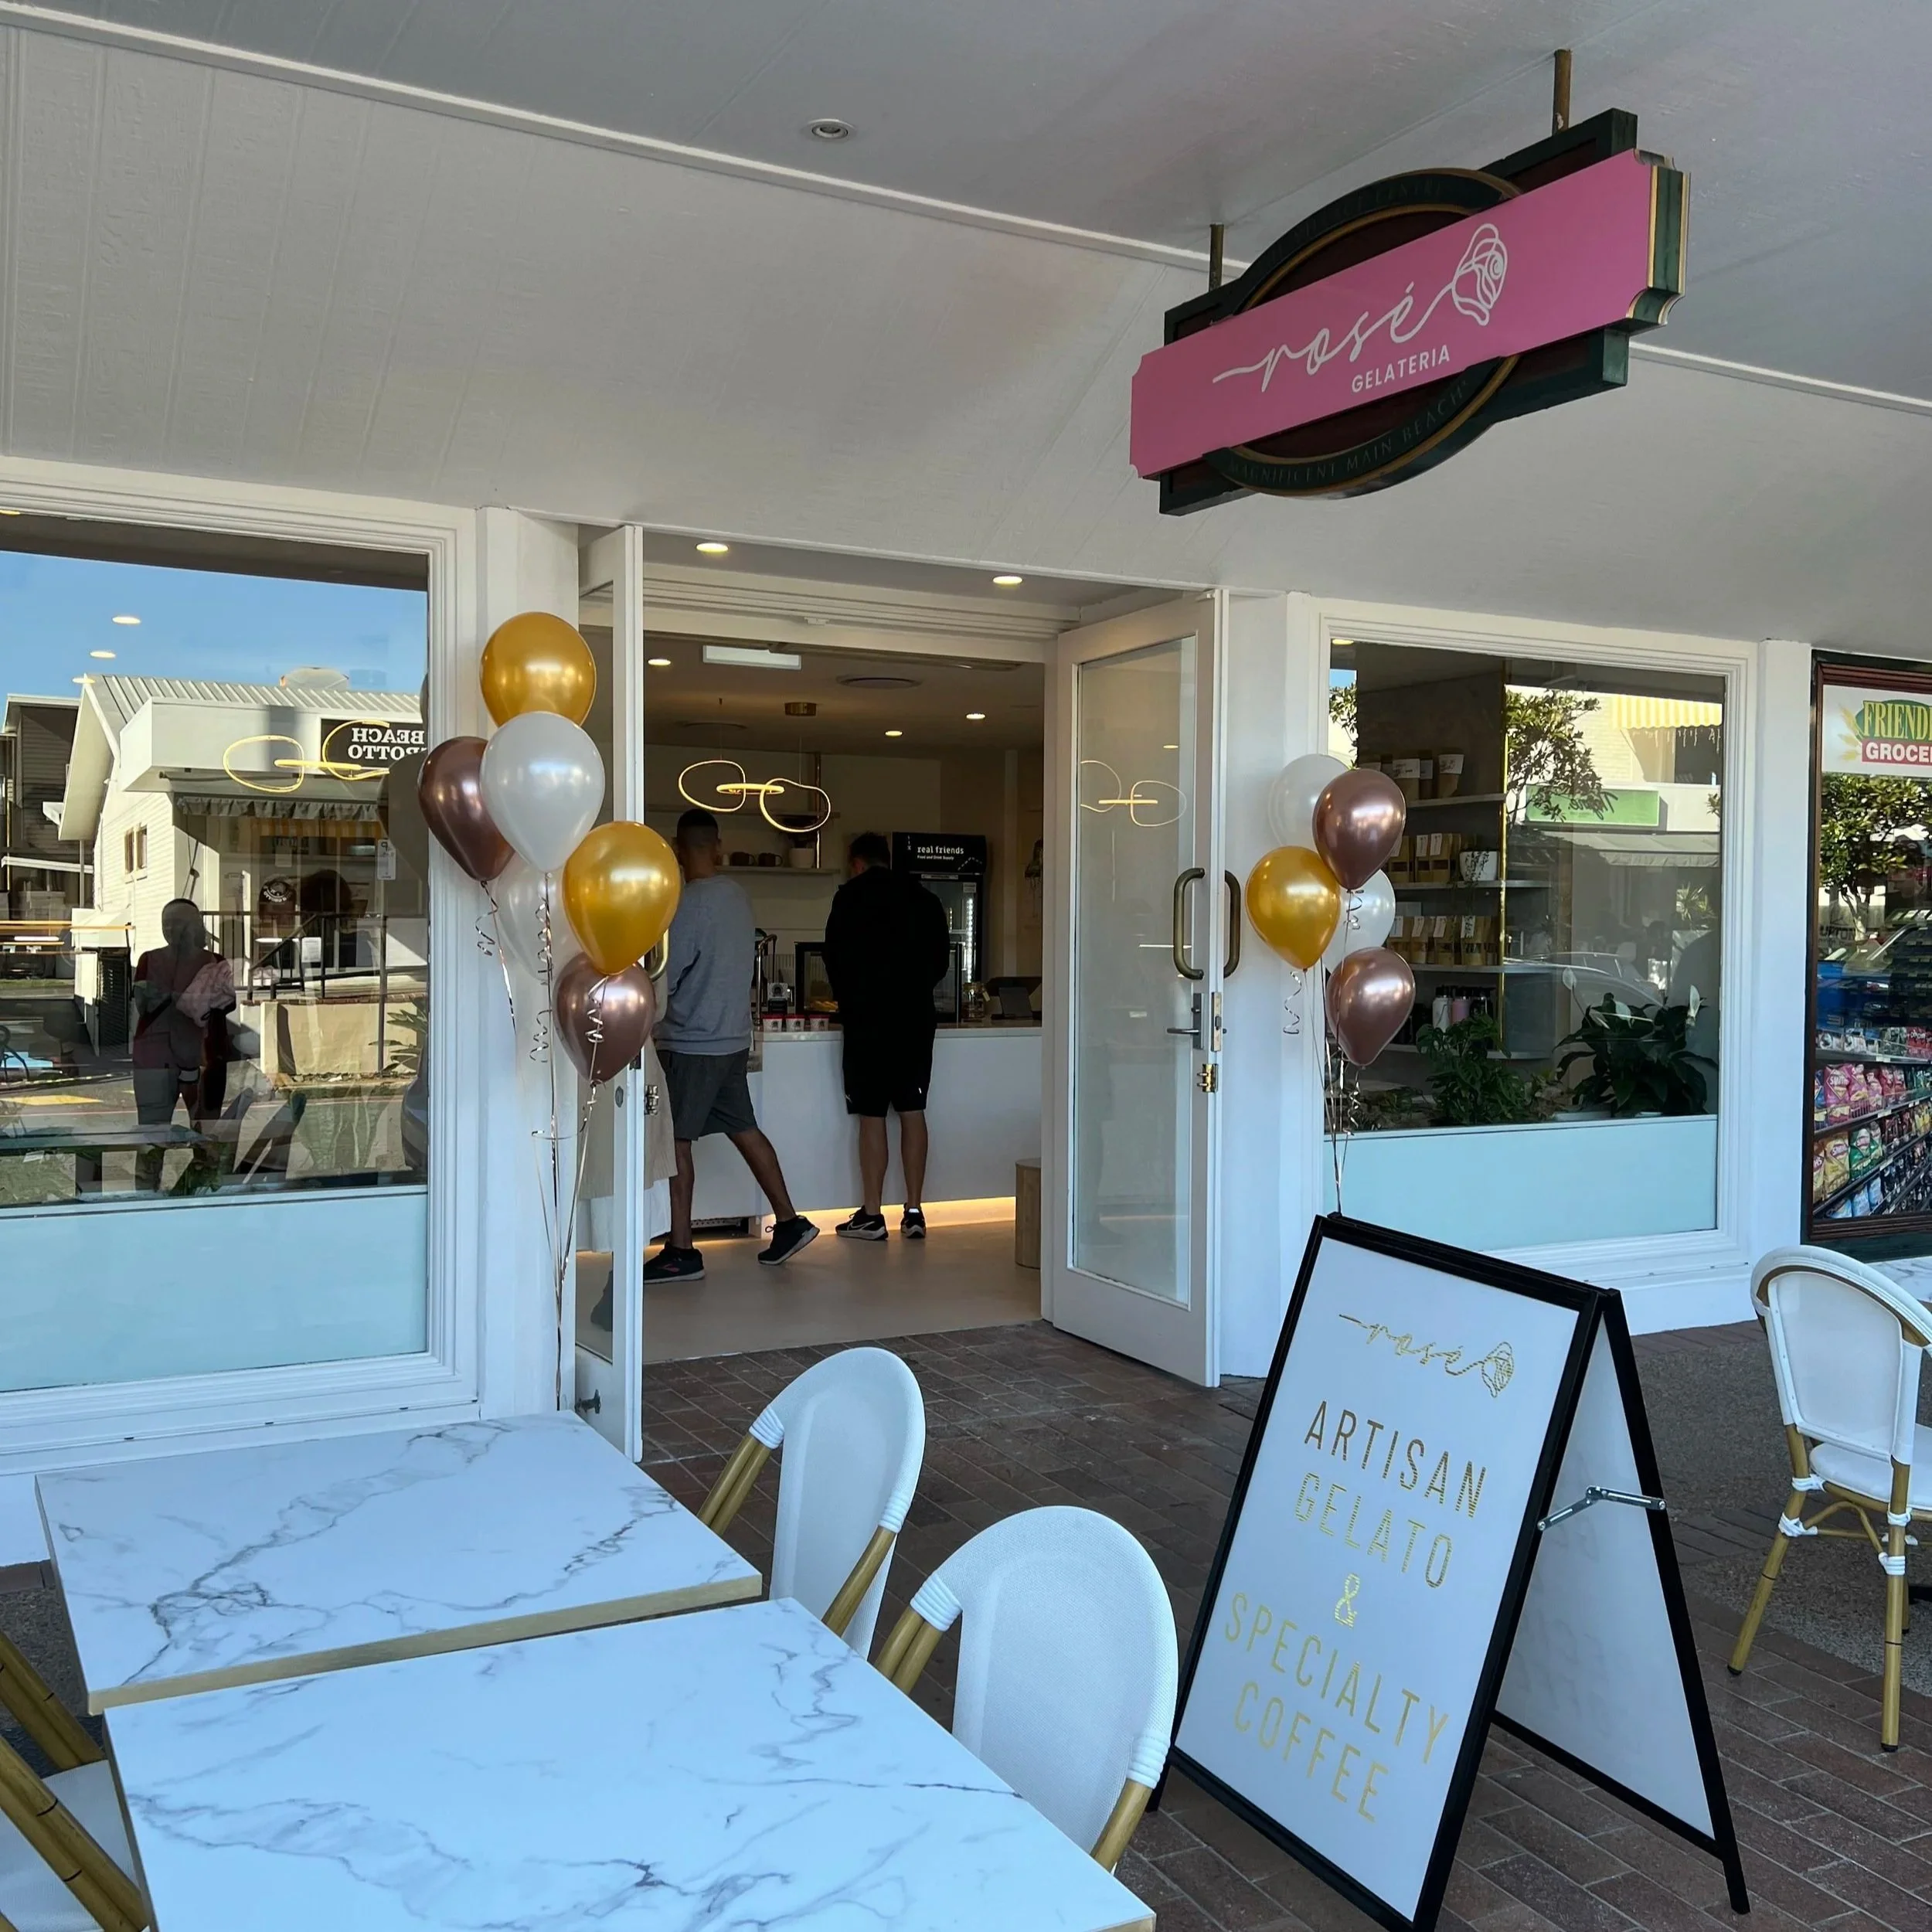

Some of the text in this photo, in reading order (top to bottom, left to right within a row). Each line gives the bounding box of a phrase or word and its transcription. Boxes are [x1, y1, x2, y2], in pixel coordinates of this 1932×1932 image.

[1351, 344, 1451, 393] GELATERIA
[1346, 438, 1393, 472] MAIN
[1863, 701, 1932, 741] FRIEND
[1866, 742, 1932, 764] GROCE
[917, 845, 964, 855] real friends
[1303, 1400, 1487, 1519] ARTISAN
[1294, 1471, 1453, 1590] GELATO
[1334, 1573, 1360, 1629] &
[1224, 1591, 1449, 1765] SPECIALTY
[1234, 1680, 1389, 1823] COFFEE
